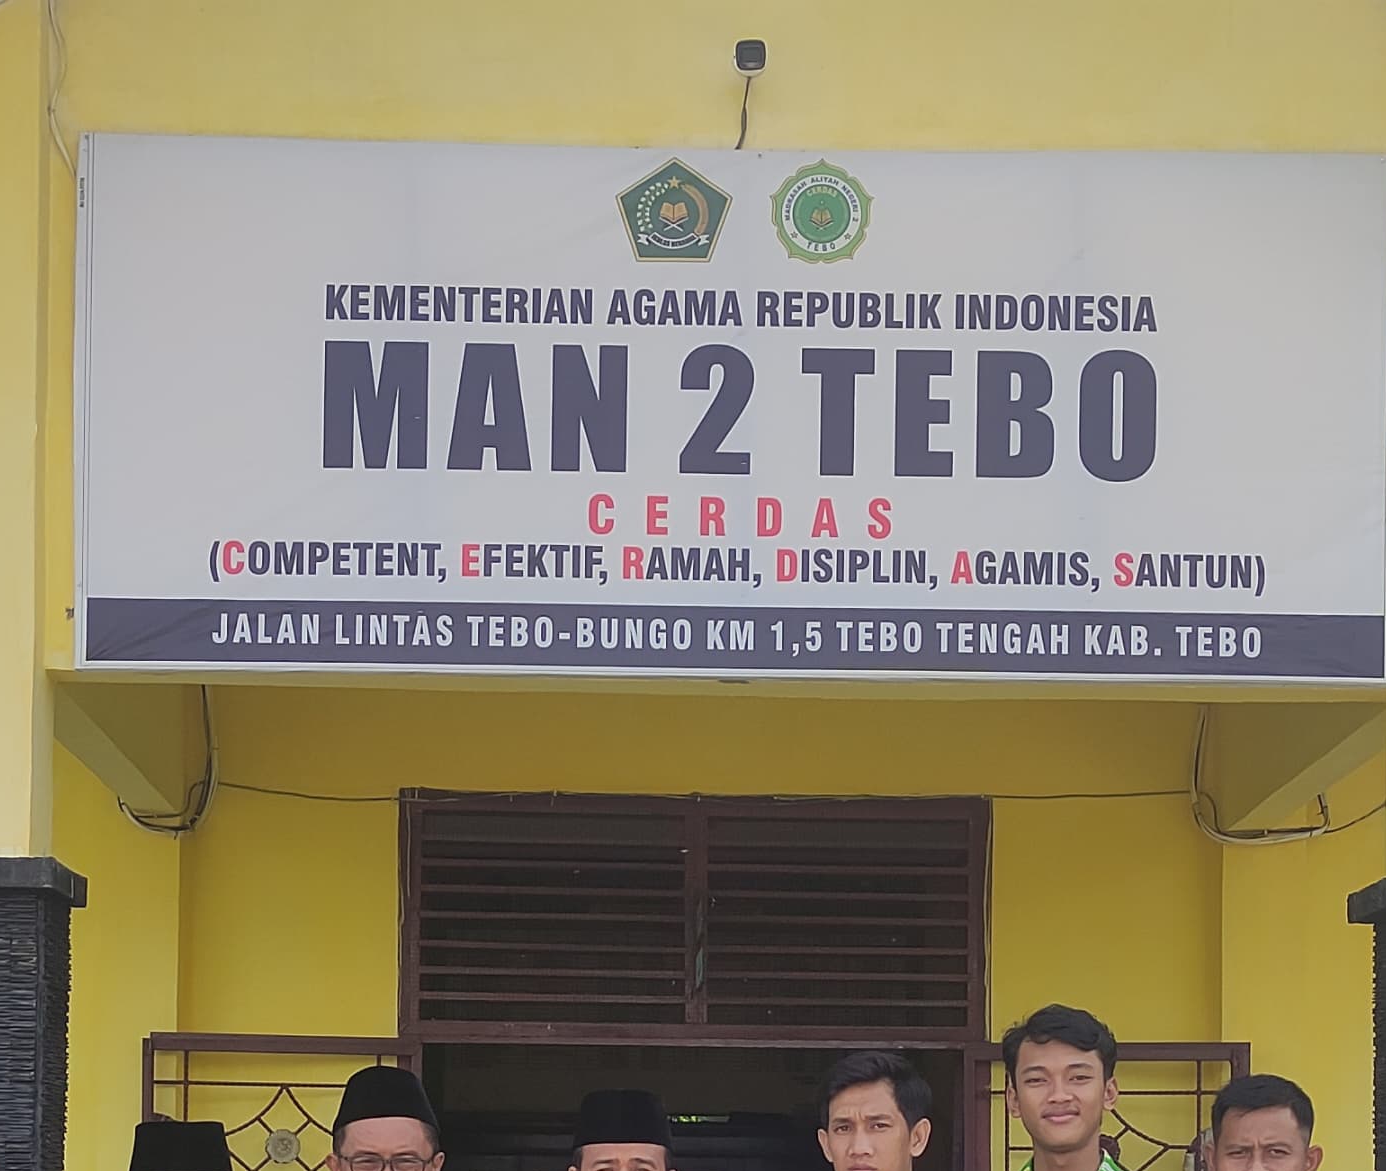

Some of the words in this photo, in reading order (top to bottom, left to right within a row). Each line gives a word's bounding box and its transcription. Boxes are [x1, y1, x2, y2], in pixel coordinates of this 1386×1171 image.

[807, 243, 836, 252] TEBO
[325, 284, 593, 324] KEMENTERIAN
[606, 288, 743, 327] AGAMA
[756, 290, 942, 329] REPUBLIK
[955, 294, 1157, 332] INDONESIA
[322, 340, 628, 472] MAN
[679, 343, 755, 475] 2
[801, 347, 1157, 482] TEBO
[209, 540, 446, 583] (COMPETENT,
[461, 543, 607, 585] EFEKTIF,
[622, 546, 761, 588] RAMAH,
[776, 548, 937, 590] DISIPLIN,
[950, 550, 1099, 593] AGAMIS,
[1113, 552, 1265, 597] SANTUN)
[211, 613, 319, 644] JALAN
[335, 610, 453, 646] LINTAS
[466, 615, 691, 650] TEBO-BUNGO
[707, 619, 754, 650] KM
[770, 620, 821, 657] 1,5
[835, 621, 921, 653] TEBO
[935, 622, 1069, 654] TENGAH
[1084, 624, 1161, 656] KAB.
[1175, 626, 1261, 658] TEBO
